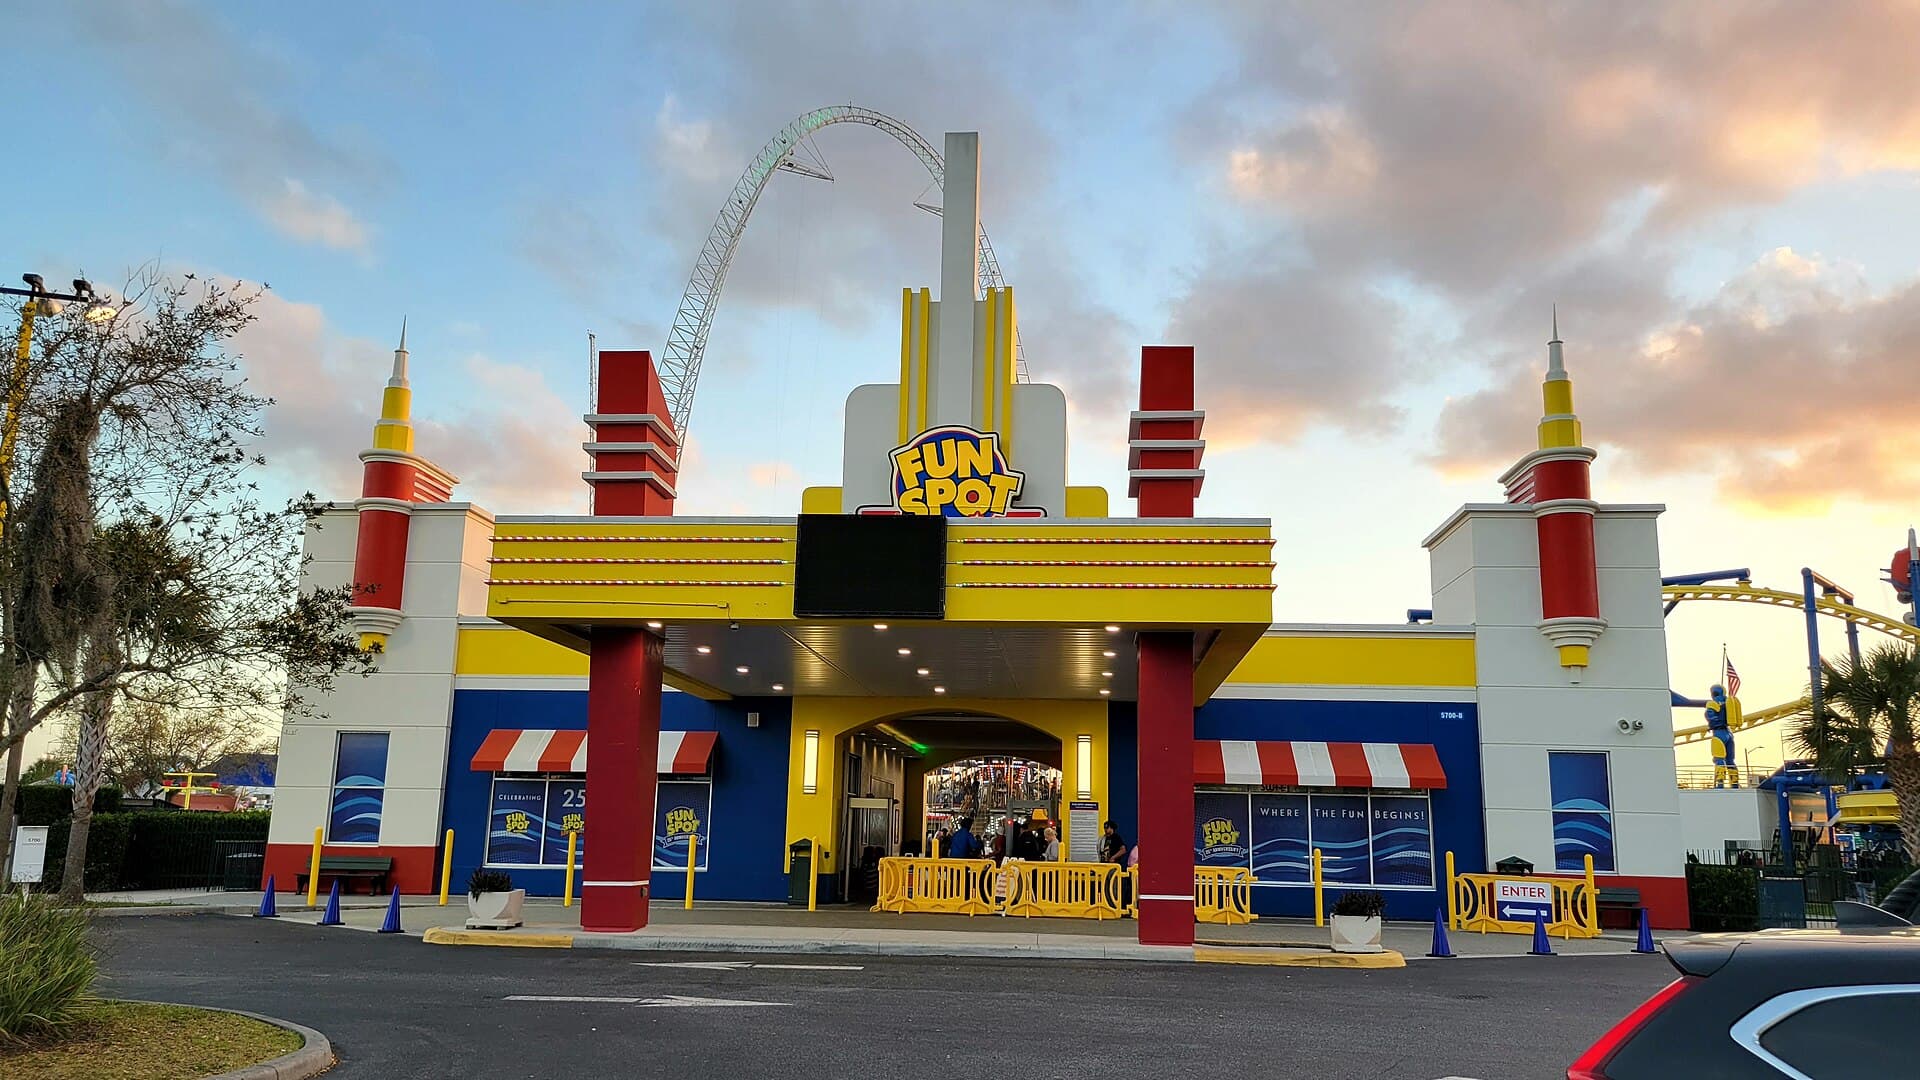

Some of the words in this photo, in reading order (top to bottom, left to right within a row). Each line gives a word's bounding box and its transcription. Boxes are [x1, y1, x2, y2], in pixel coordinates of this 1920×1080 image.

[895, 438, 993, 488] FUN
[899, 473, 1020, 516] SPOT
[562, 788, 586, 807] 25
[506, 812, 526, 824] FUN
[562, 813, 581, 824] FUN
[665, 808, 694, 823] FUN
[1260, 807, 1300, 817] WHERE
[1314, 808, 1336, 818] THE
[1341, 809, 1364, 818] FUN
[1374, 809, 1425, 820] BEGINS!
[506, 820, 531, 832] SPOT
[563, 820, 584, 832] SPOT
[667, 819, 700, 836] SPOT
[1202, 820, 1232, 835] FUN
[1205, 831, 1240, 848] SPOT
[1501, 885, 1546, 898] ENTER
